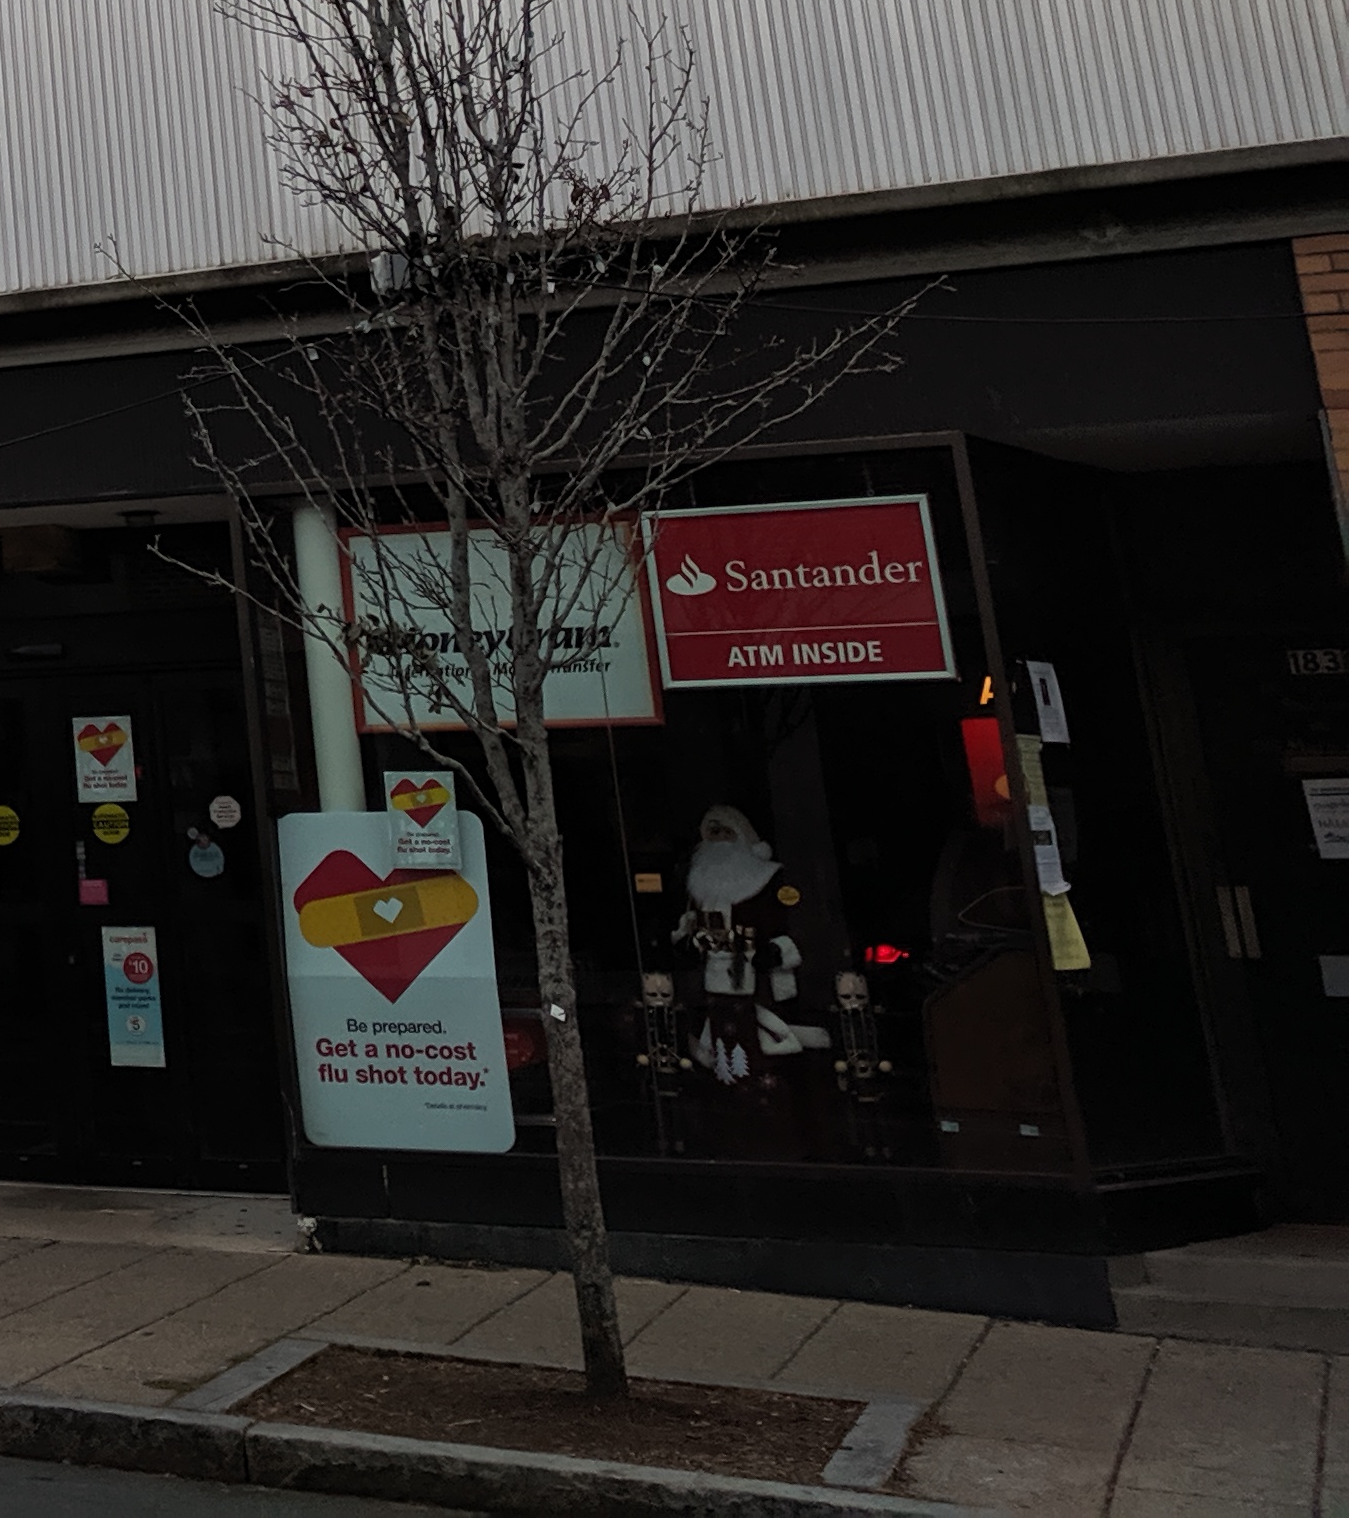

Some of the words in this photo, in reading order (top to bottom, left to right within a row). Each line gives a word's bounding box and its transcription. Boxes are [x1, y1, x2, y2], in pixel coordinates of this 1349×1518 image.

[725, 549, 923, 592] Santander
[728, 644, 784, 667] ATM
[792, 640, 884, 666] INSIDE
[347, 1018, 368, 1033] Be
[372, 1019, 447, 1036] prepared.
[316, 1038, 358, 1057] Get
[365, 1042, 378, 1057] a
[386, 1042, 476, 1061] no-cost
[318, 1064, 348, 1083] flu
[355, 1065, 407, 1086] shot
